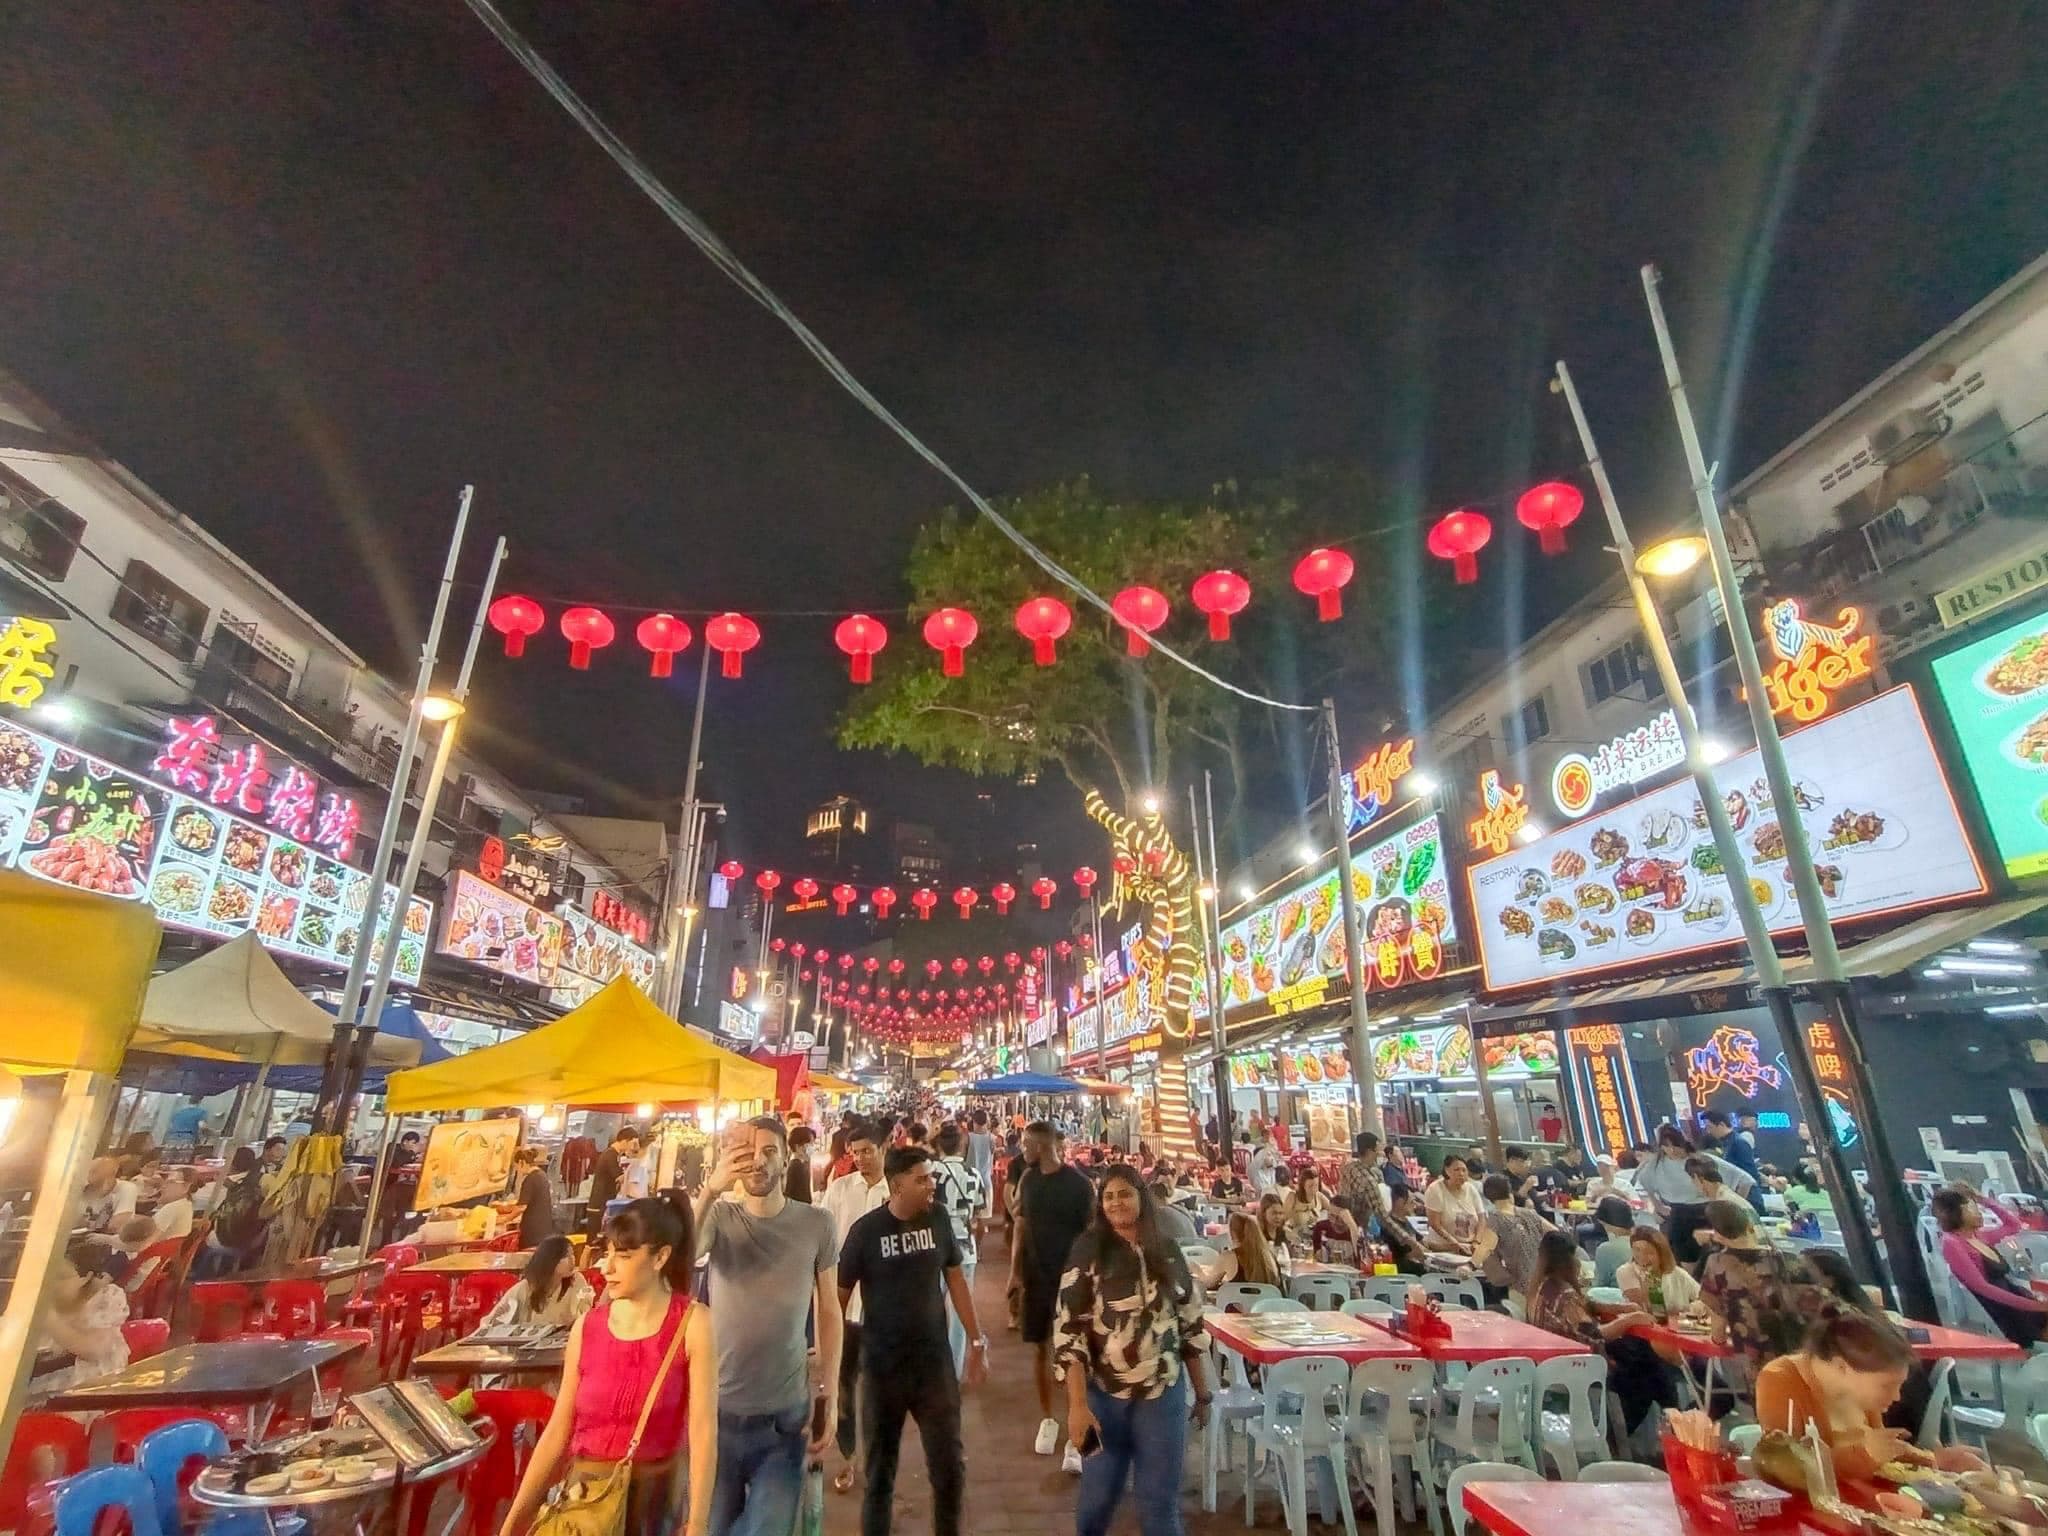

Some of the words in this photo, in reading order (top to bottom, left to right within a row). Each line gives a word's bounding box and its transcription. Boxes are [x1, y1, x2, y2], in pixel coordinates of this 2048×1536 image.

[1640, 744, 1682, 771] BREAK
[1354, 739, 1414, 806] Tiger
[1470, 804, 1529, 854] Tiger
[1480, 864, 1521, 887] RESTORAN
[880, 1235, 900, 1258] BE
